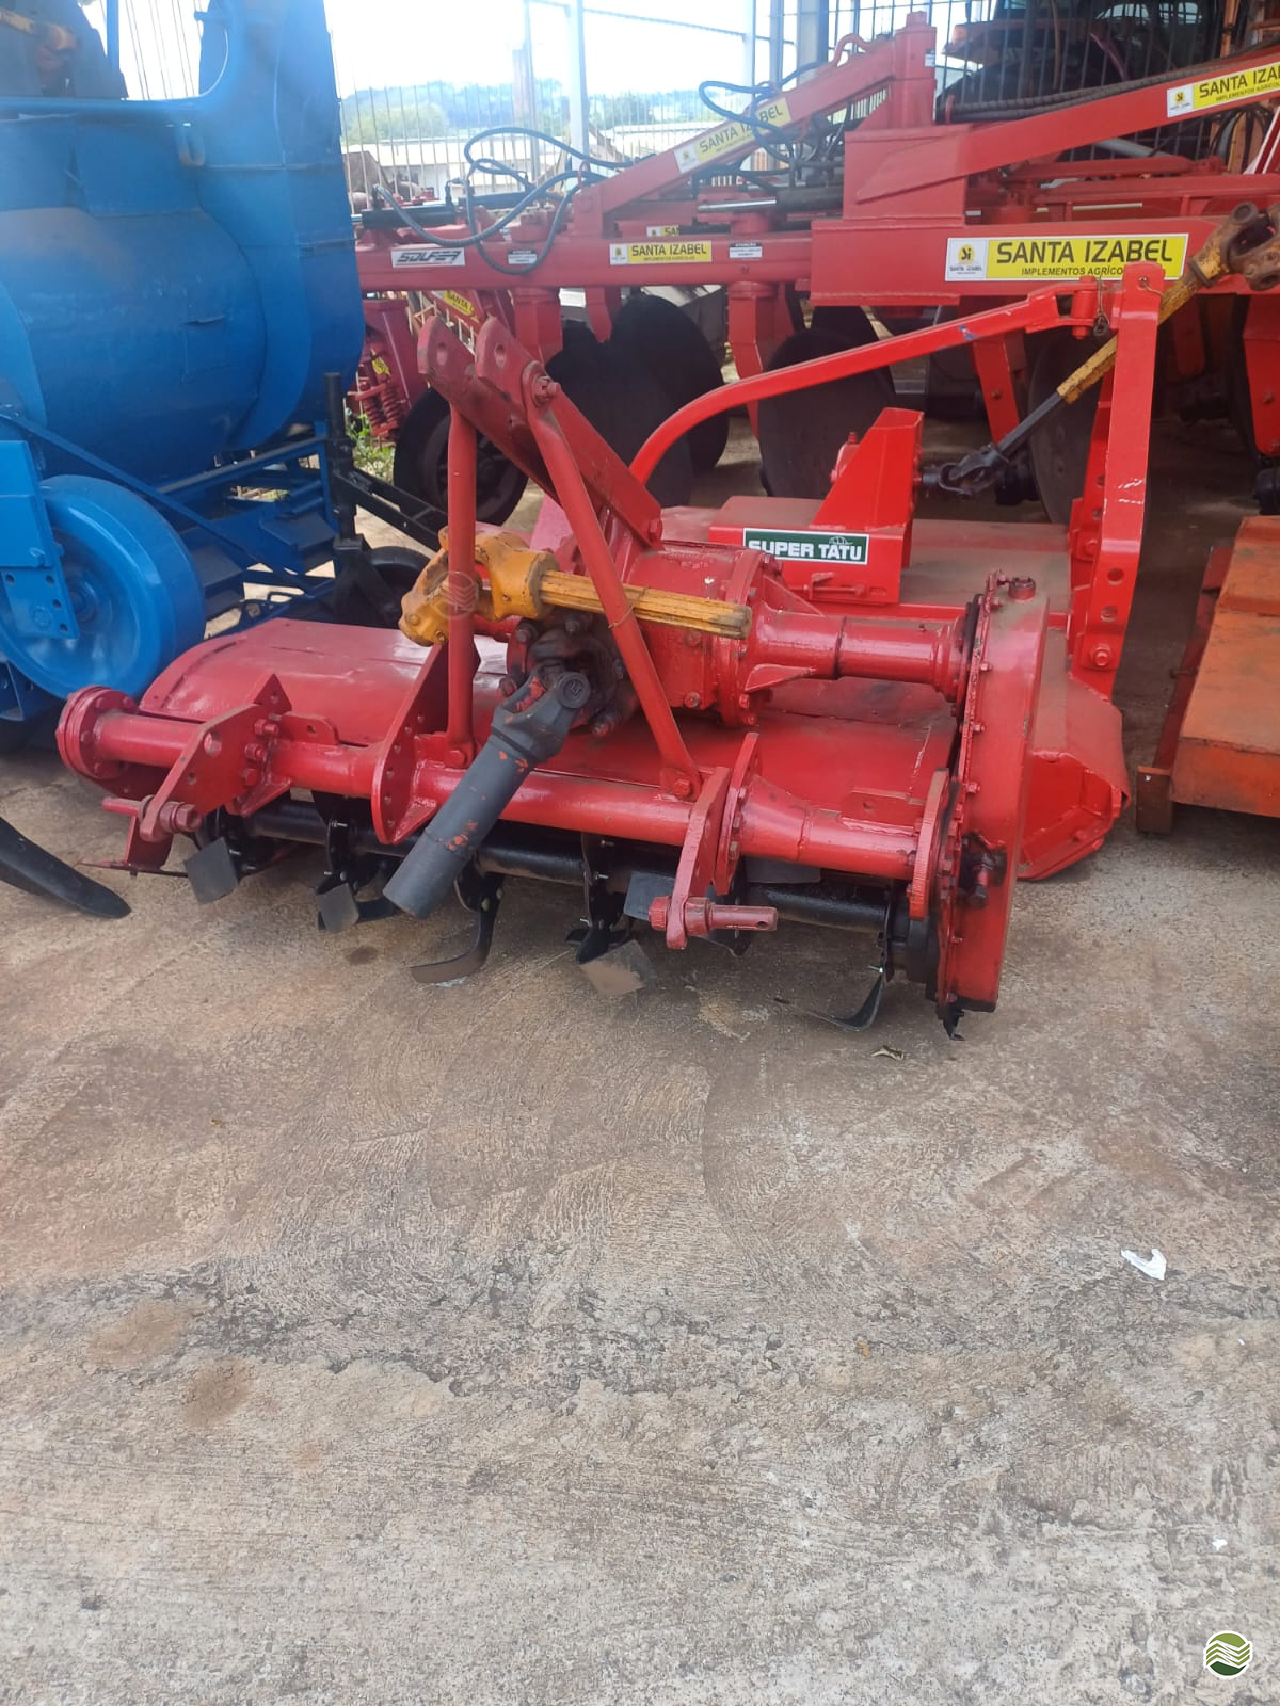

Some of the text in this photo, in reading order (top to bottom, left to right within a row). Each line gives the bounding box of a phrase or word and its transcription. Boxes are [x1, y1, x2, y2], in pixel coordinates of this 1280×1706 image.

[1199, 76, 1247, 98] SANTA
[700, 127, 738, 152] SANTA
[741, 106, 784, 131] IZBEL
[665, 227, 678, 237] SA
[632, 243, 706, 256] SANTA IZABEL
[996, 240, 1172, 264] SANTA IZABEL
[1022, 265, 1123, 275] IMPLEMENTOS AGRÍCO
[748, 540, 862, 560] SUPER TATU
